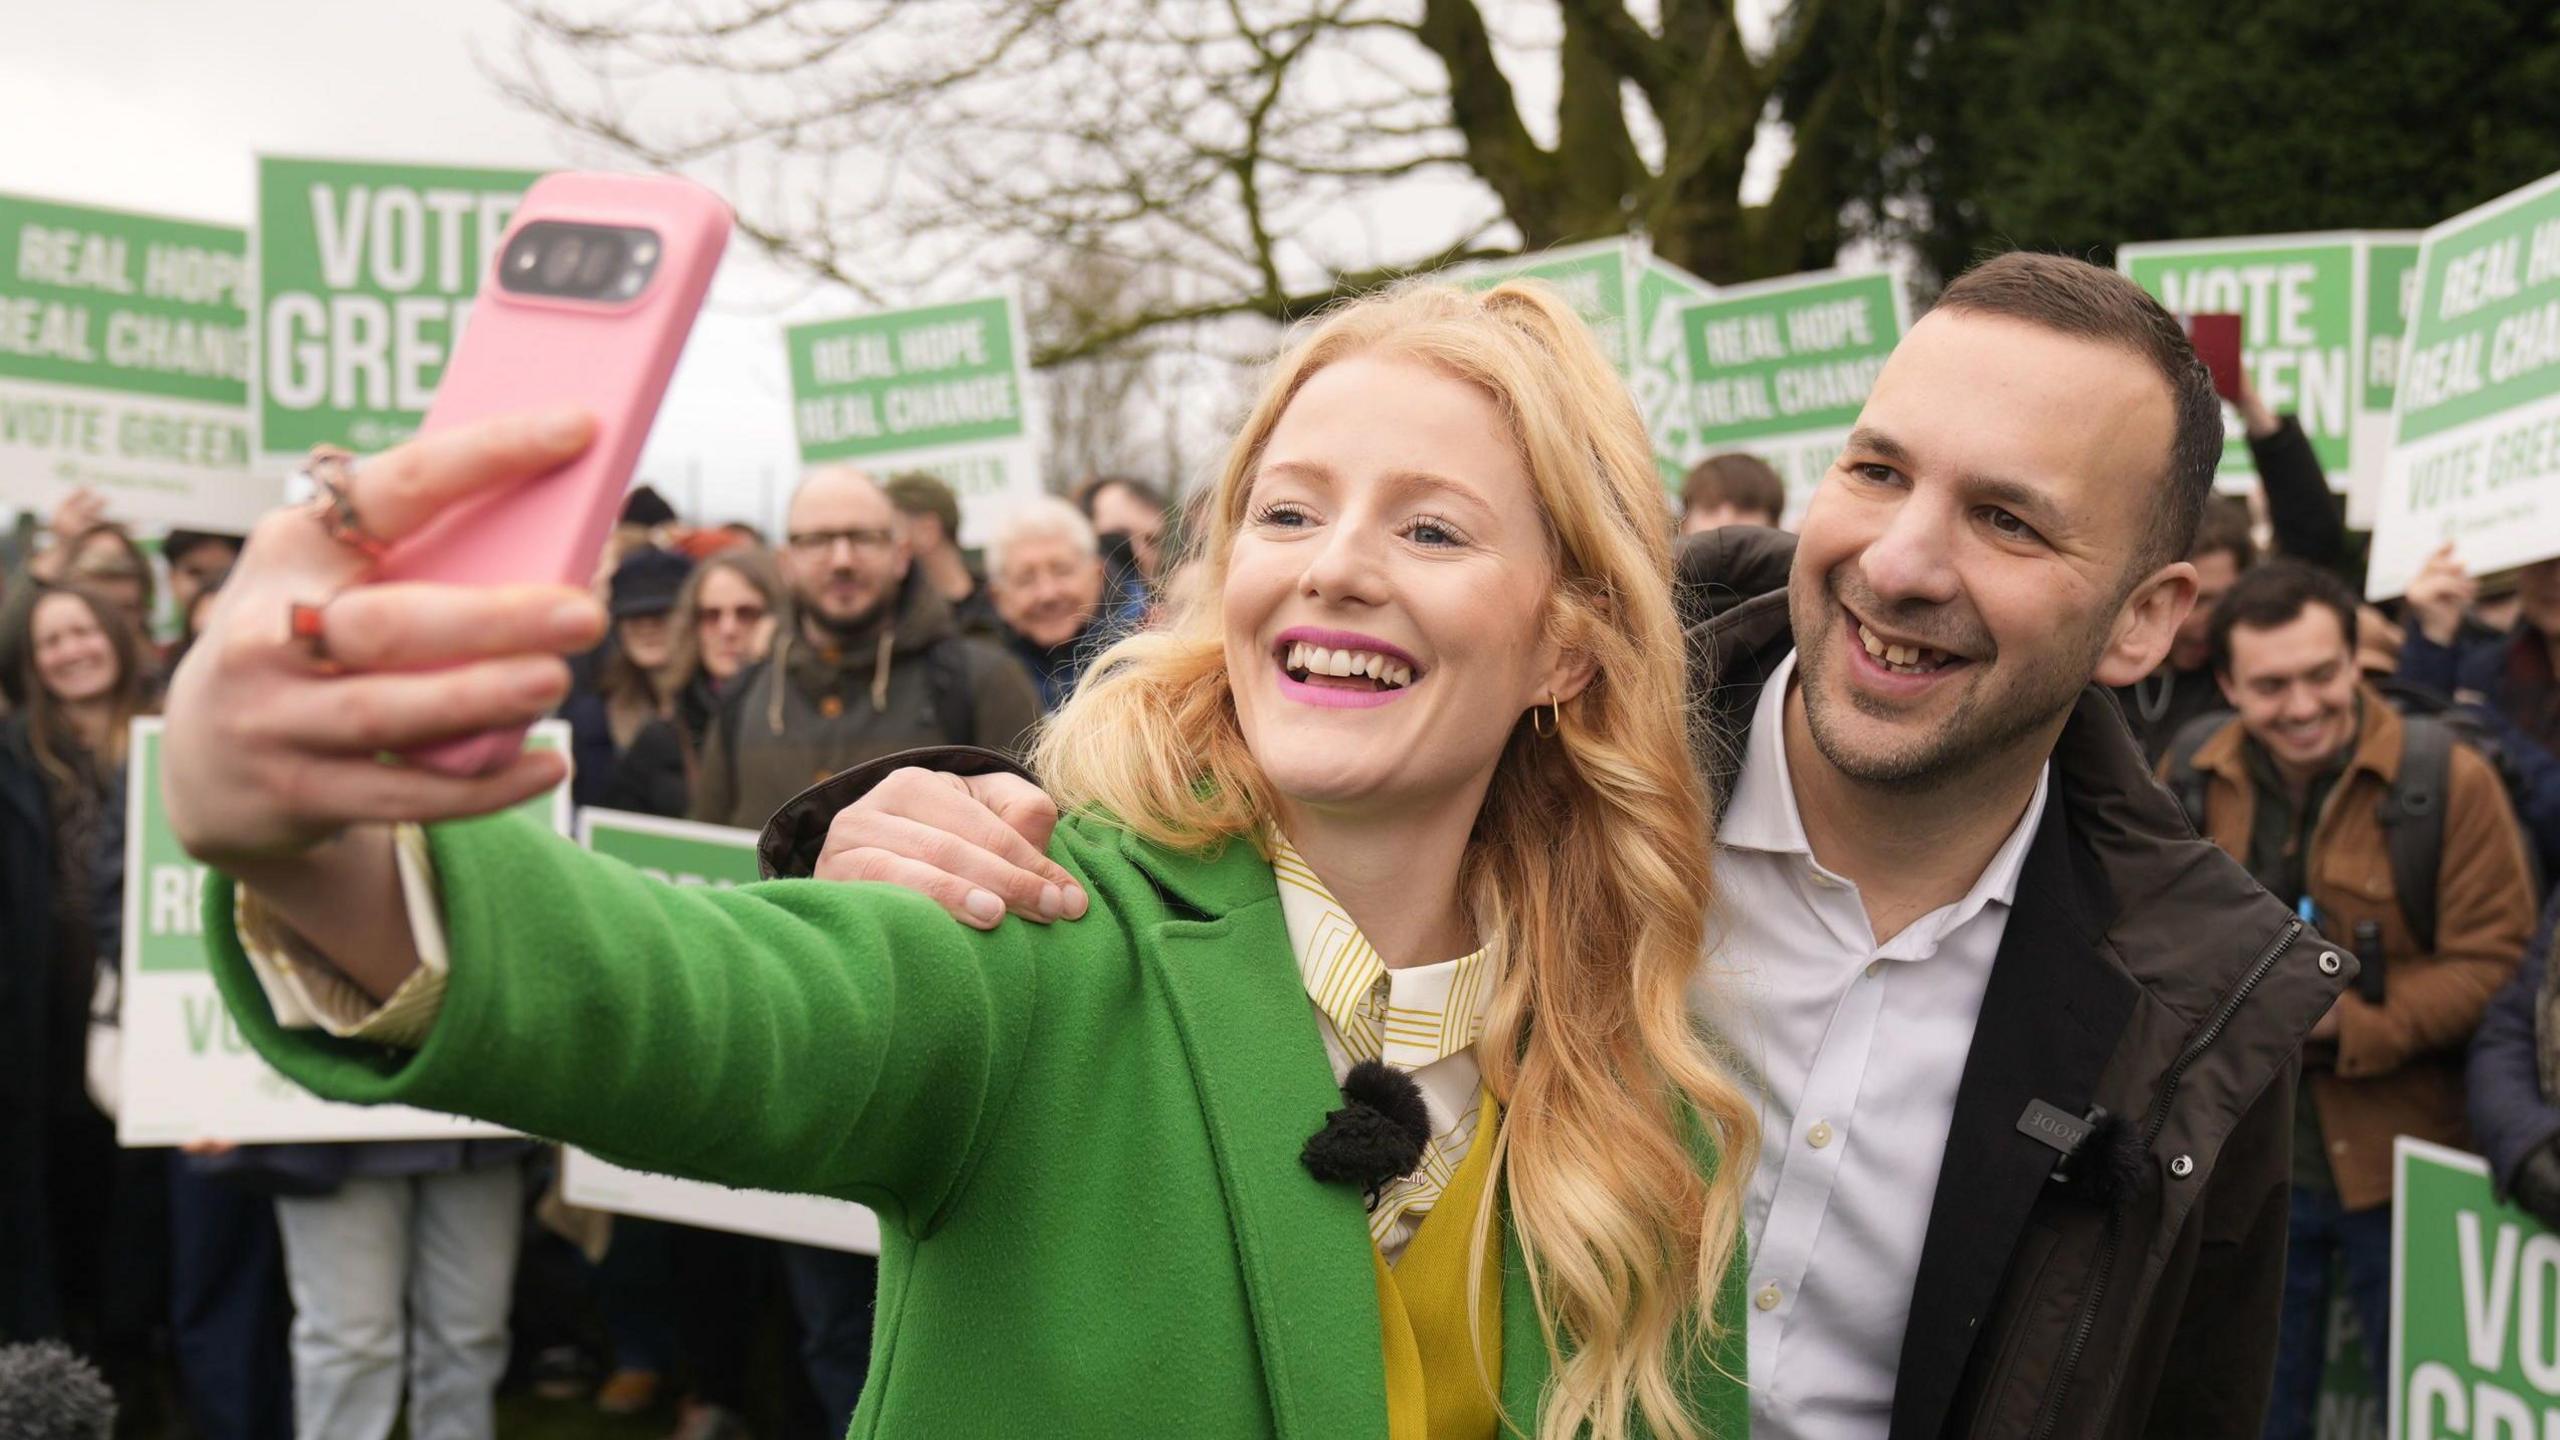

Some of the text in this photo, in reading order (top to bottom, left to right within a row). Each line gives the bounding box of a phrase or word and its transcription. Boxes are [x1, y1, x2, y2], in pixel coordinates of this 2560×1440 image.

[20, 225, 134, 294] REAL
[2438, 234, 2522, 321] REAL
[267, 291, 473, 410] GRE
[814, 318, 987, 385] REAL HOPE
[1707, 297, 1872, 368] REAL HOPE
[1777, 355, 1890, 416] CHANG
[2402, 327, 2487, 417] REAL
[2406, 436, 2484, 515] VOTE
